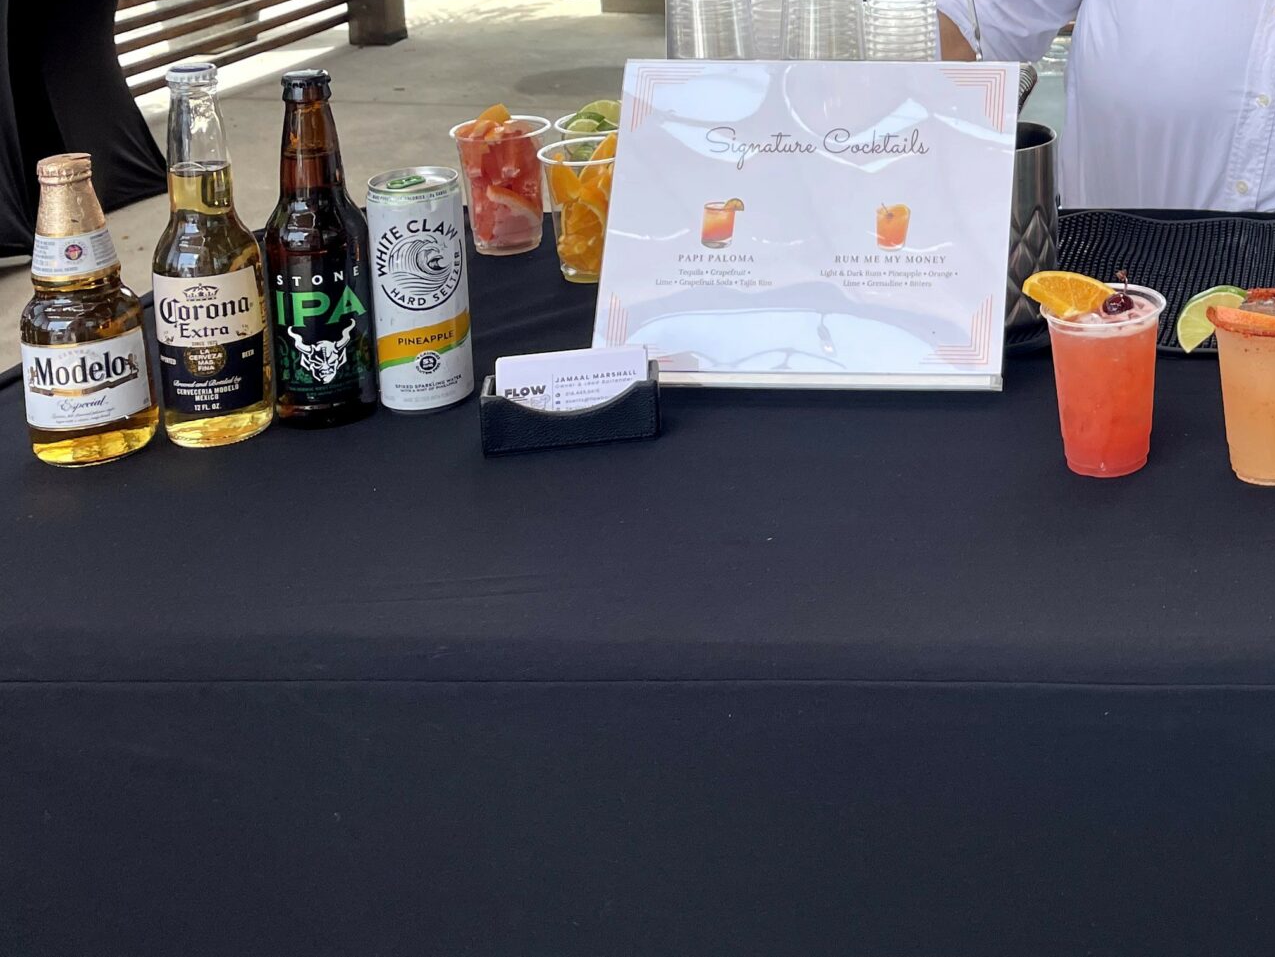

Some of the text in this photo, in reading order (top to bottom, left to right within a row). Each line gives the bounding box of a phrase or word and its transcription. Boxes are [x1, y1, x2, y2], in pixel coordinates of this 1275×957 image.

[706, 126, 930, 170] Signature Cocktails
[376, 219, 458, 278] WHITE CLAW
[678, 254, 755, 262] PAPI PALOMA
[835, 255, 947, 264] RUM ME MY MONEY
[276, 265, 360, 287] STONE
[390, 251, 460, 306] HARD SELTZER
[679, 269, 746, 277] Tequila Grapefruit
[820, 270, 837, 278] Light
[888, 270, 922, 278] Pineapple
[928, 271, 953, 279] Orange
[655, 278, 673, 286] Lime
[679, 278, 714, 288] Grapefruit
[160, 296, 250, 328] Corona
[275, 285, 367, 328] IPA
[180, 323, 230, 339] Extra
[398, 331, 454, 345] PINEAPPLE
[35, 351, 126, 386] Modelo
[555, 369, 637, 384] JAMAAL MARSHALL
[176, 384, 239, 396] CERVECERIA MODELO
[504, 385, 546, 398] FLOW
[60, 395, 107, 412] Especial
[195, 394, 219, 402] MEXICO
